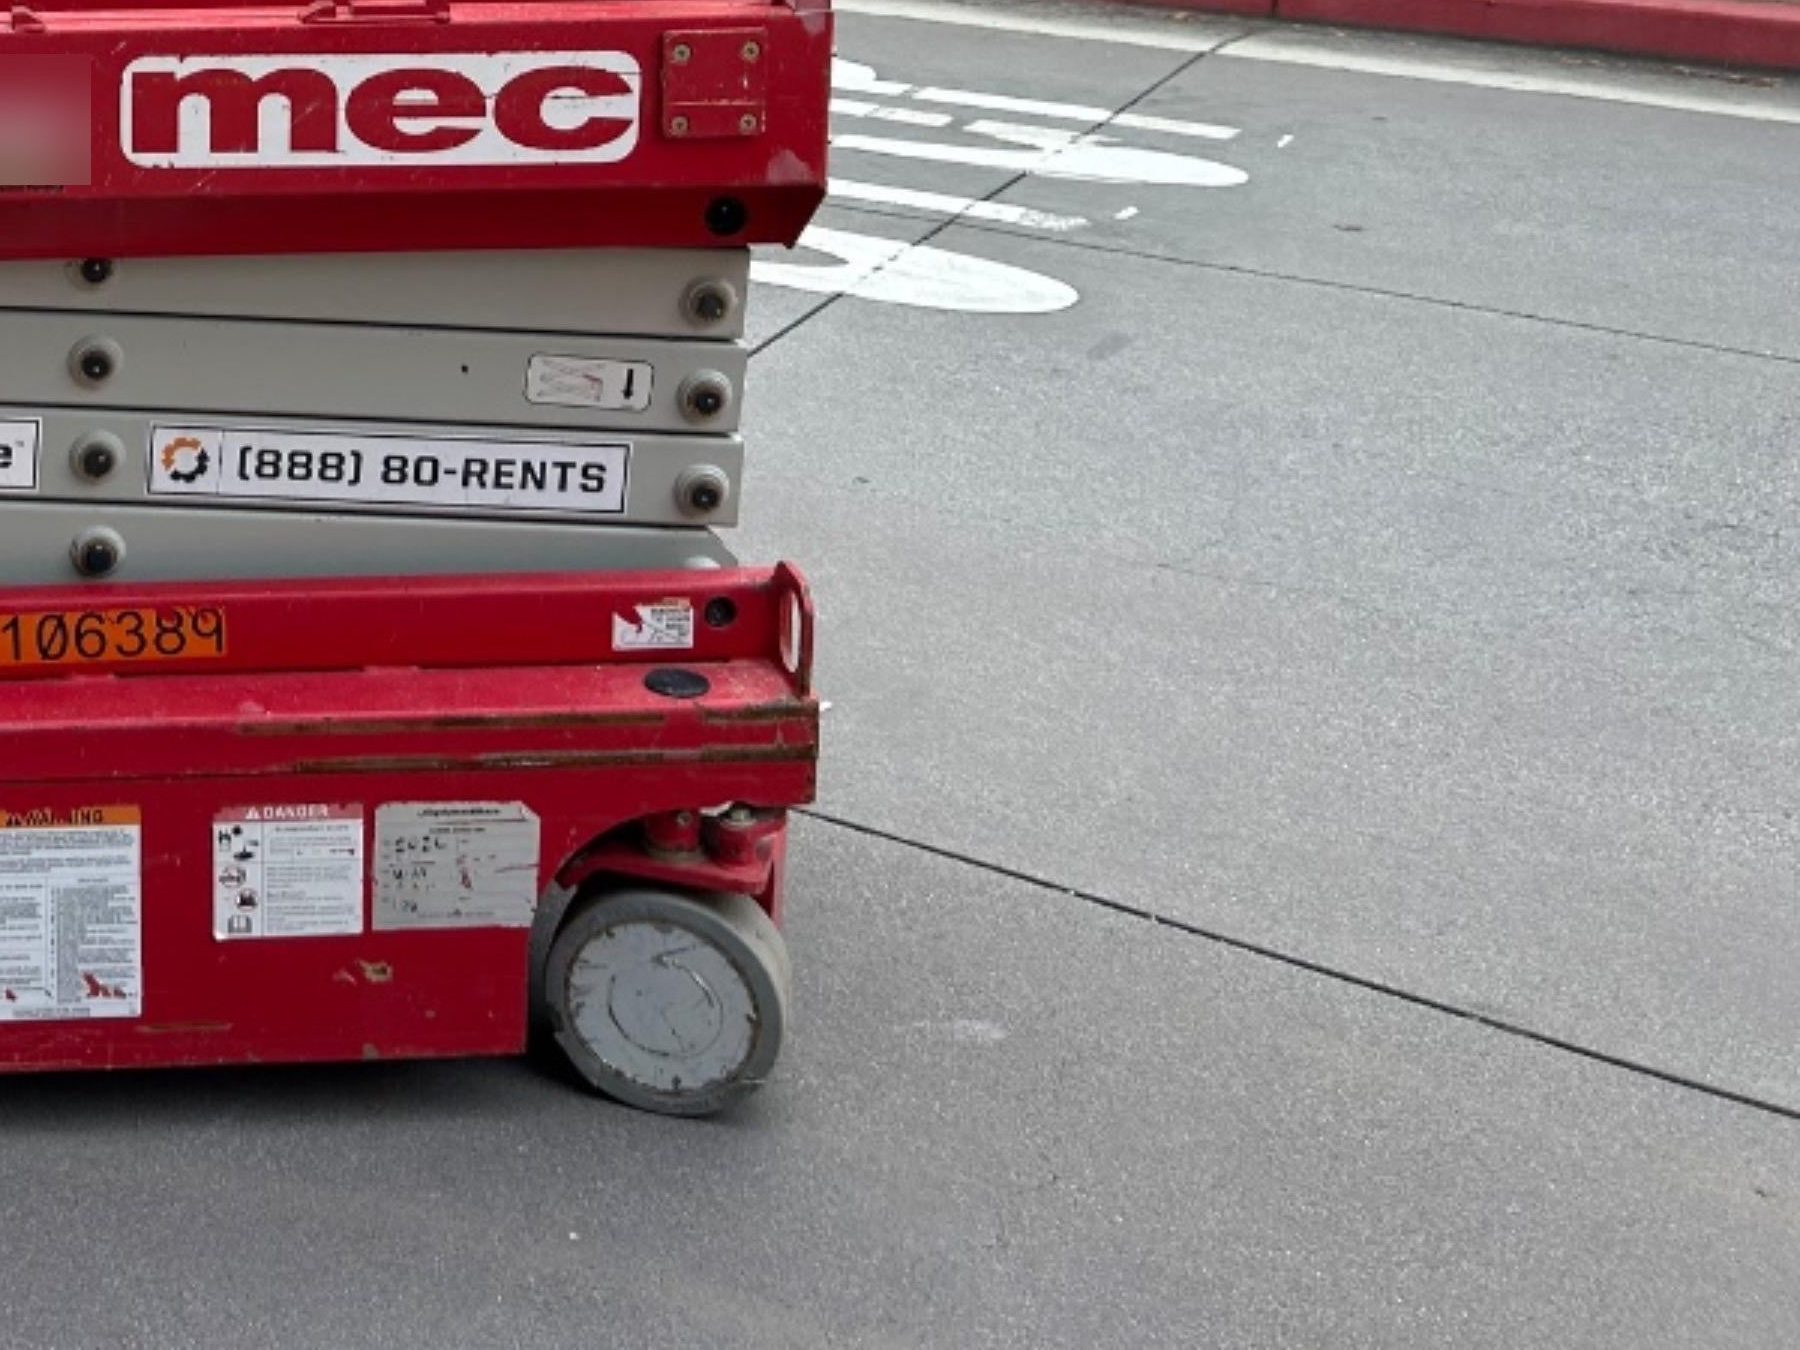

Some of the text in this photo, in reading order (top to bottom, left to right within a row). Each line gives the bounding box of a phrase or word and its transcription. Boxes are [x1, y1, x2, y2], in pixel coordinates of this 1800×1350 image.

[130, 65, 635, 154] mec
[380, 453, 608, 493] 80-RENTS
[1, 608, 224, 662] 106389
